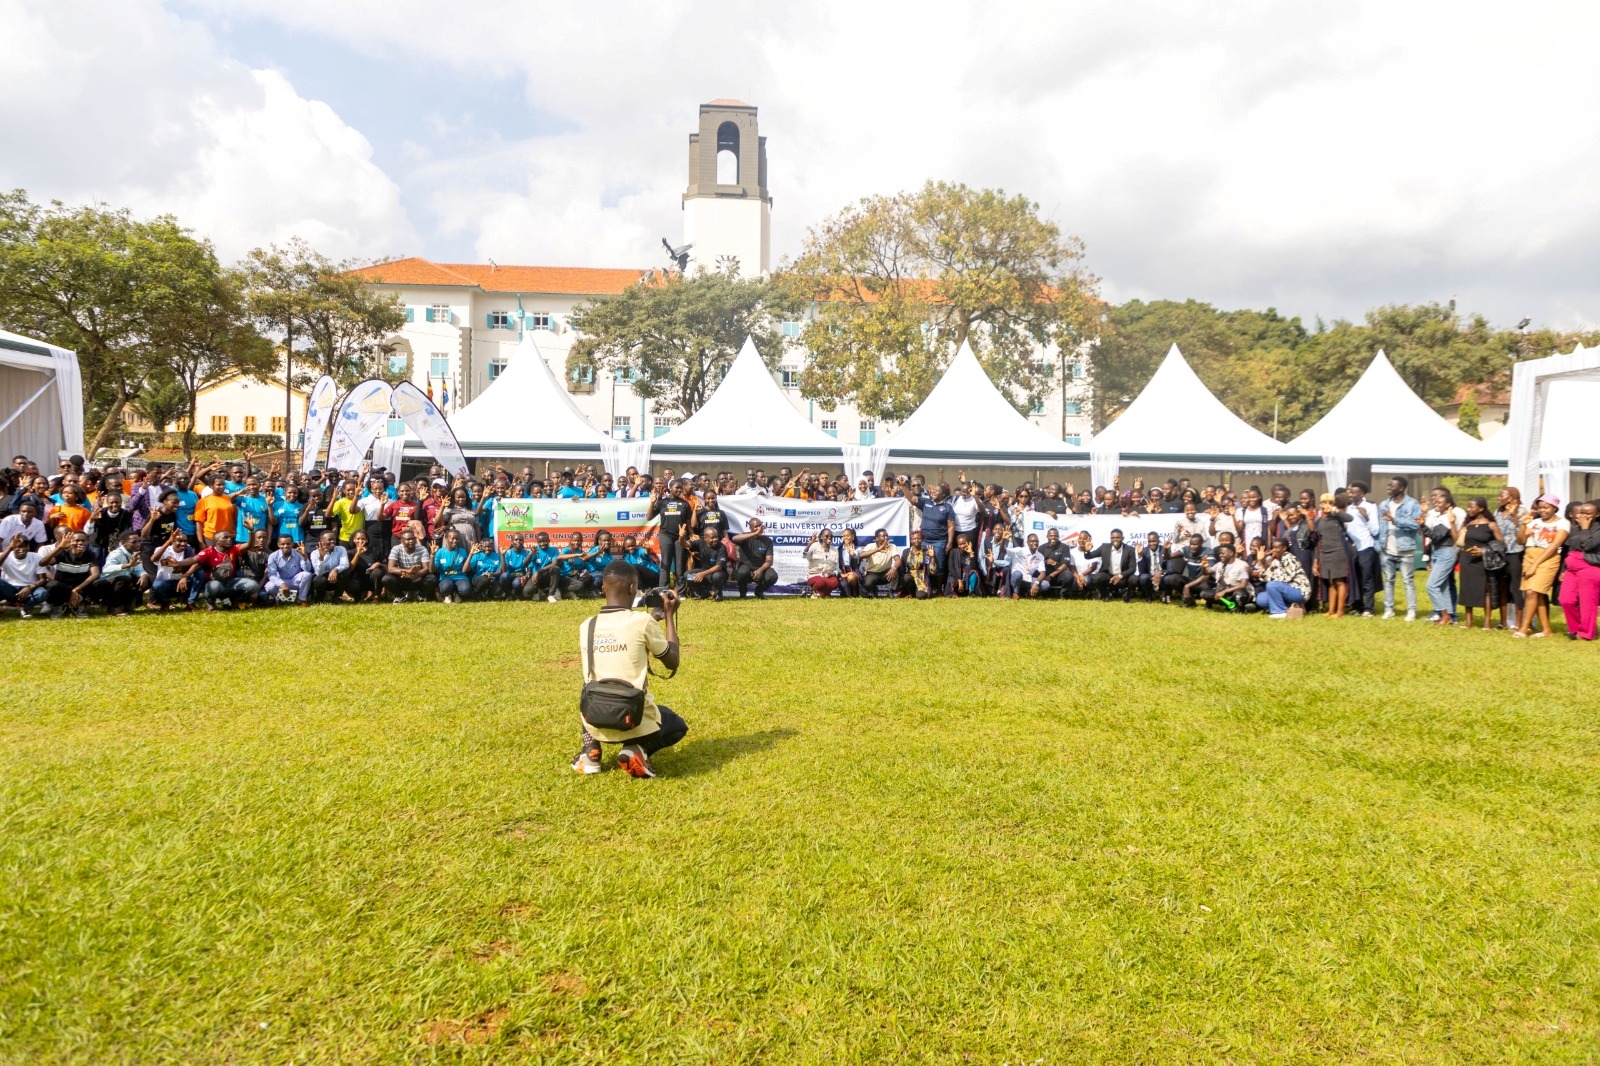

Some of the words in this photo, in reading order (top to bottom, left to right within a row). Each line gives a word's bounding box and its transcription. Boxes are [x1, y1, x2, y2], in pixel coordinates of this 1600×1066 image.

[780, 522, 827, 530] UNIVERSITY
[845, 522, 865, 530] PLUS
[628, 531, 660, 539] CAMPS
